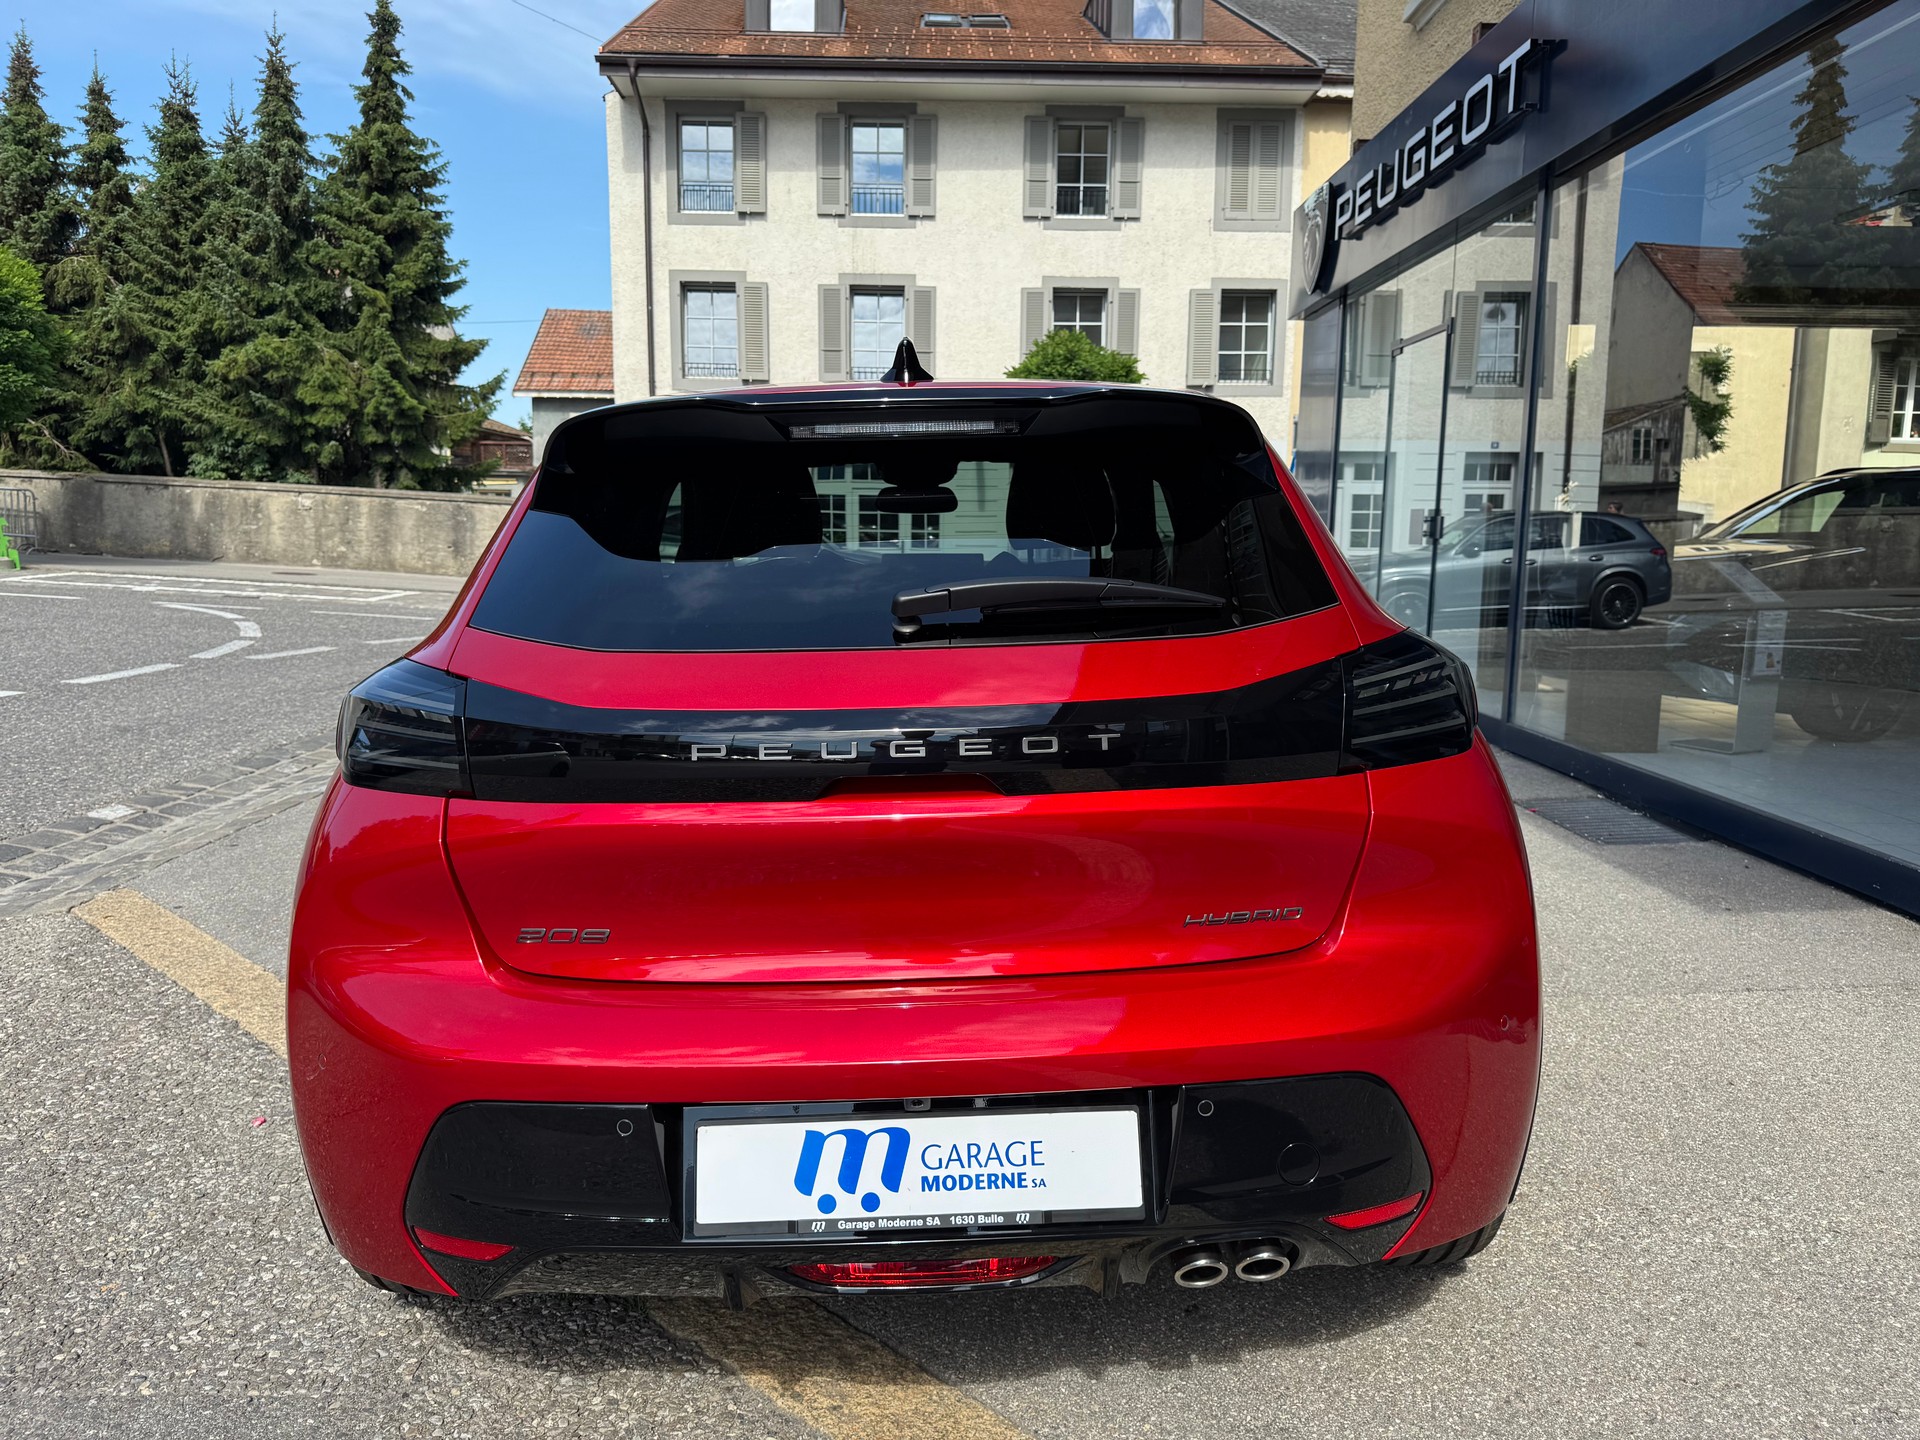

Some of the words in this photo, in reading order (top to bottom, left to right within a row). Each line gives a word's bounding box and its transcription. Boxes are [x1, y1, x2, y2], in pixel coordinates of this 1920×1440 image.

[1335, 40, 1531, 241] PEUGEOT
[691, 733, 1121, 761] PEUGEOT
[1184, 906, 1304, 928] HYBRID
[517, 927, 611, 944] 208
[920, 1140, 1046, 1170] GARAGE
[921, 1172, 1028, 1192] MODERNE
[1031, 1178, 1047, 1188] SA
[837, 1219, 876, 1230] Garage
[878, 1217, 924, 1228] Moderne
[926, 1214, 941, 1226] SA
[949, 1215, 975, 1225] 1630
[977, 1214, 1004, 1224] Bulle
